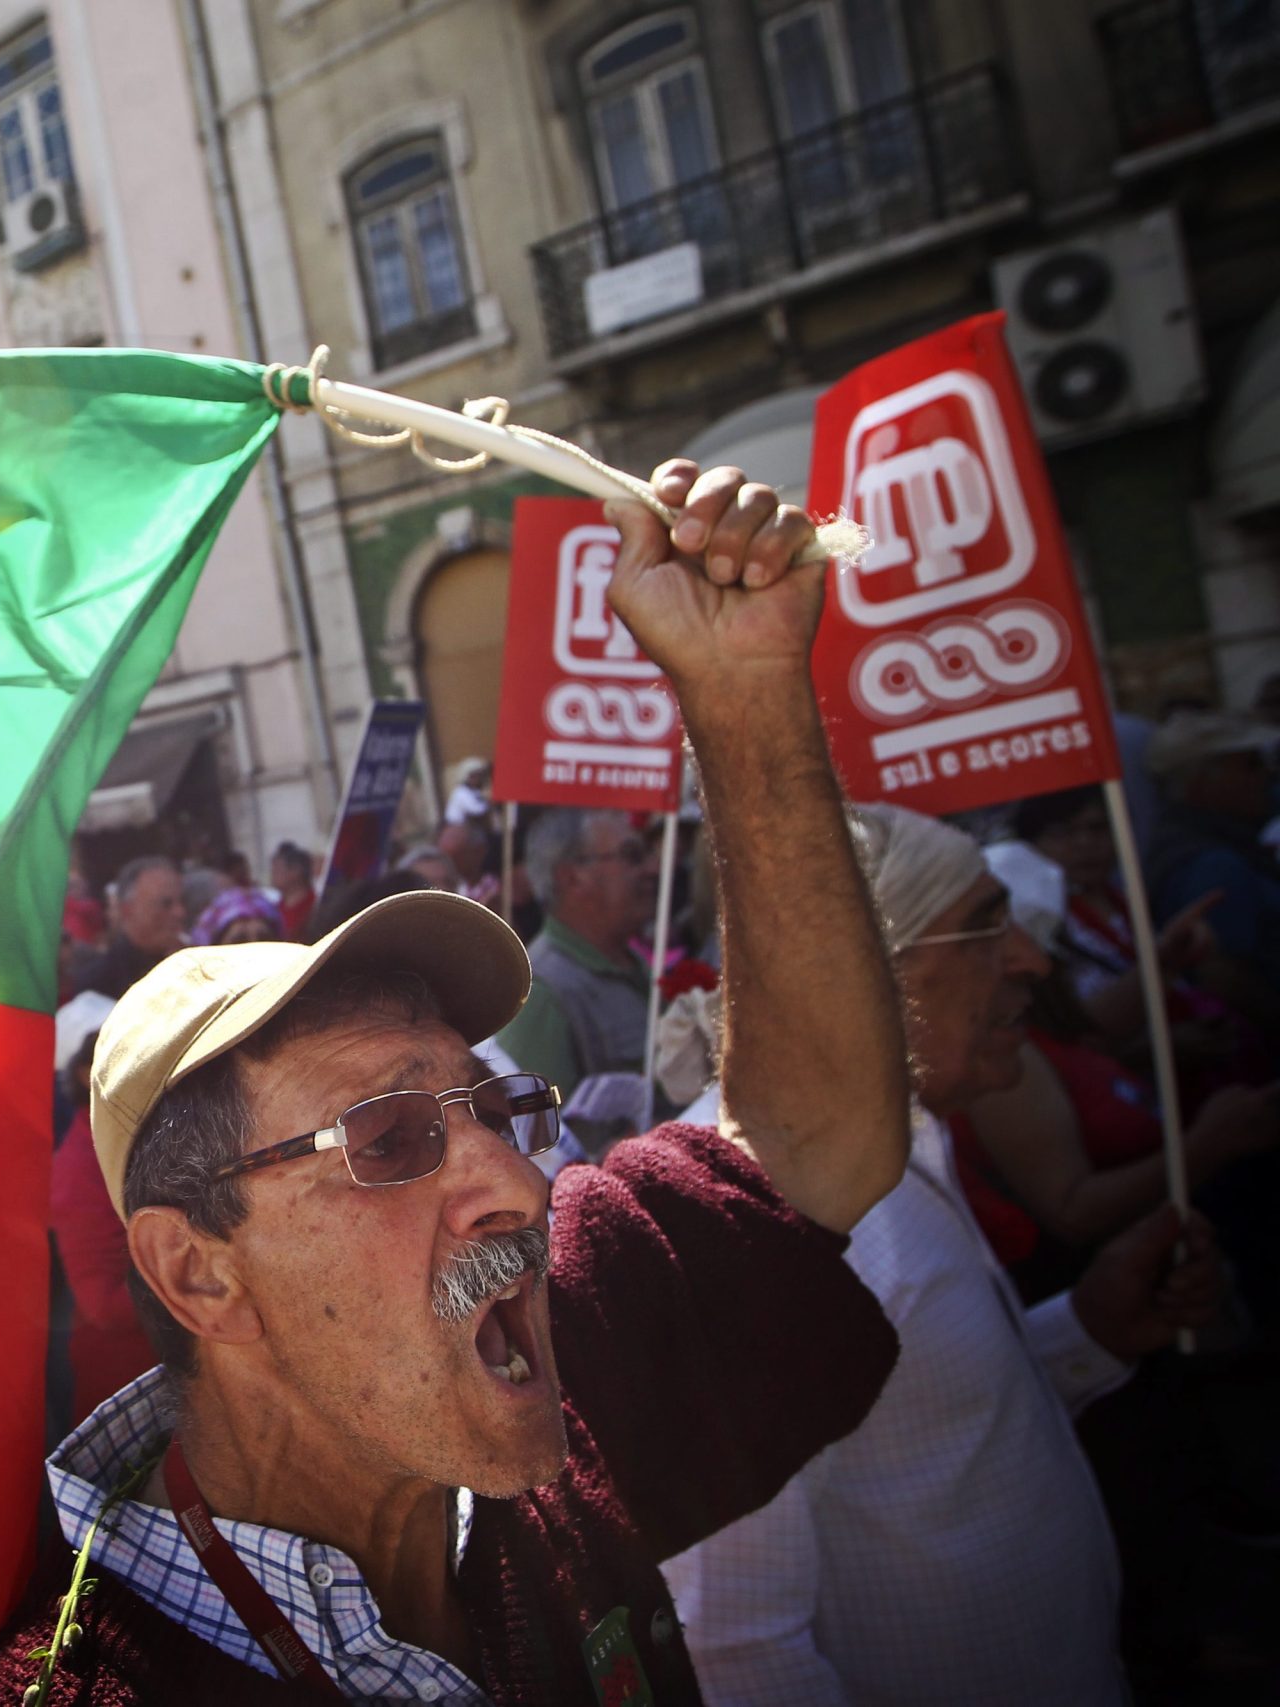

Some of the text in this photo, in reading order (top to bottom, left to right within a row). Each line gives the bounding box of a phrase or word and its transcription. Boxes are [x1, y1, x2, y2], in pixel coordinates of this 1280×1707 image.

[573, 543, 639, 658] f
[544, 761, 575, 784] sul
[581, 765, 592, 784] e
[880, 721, 1091, 791] sul e açores
